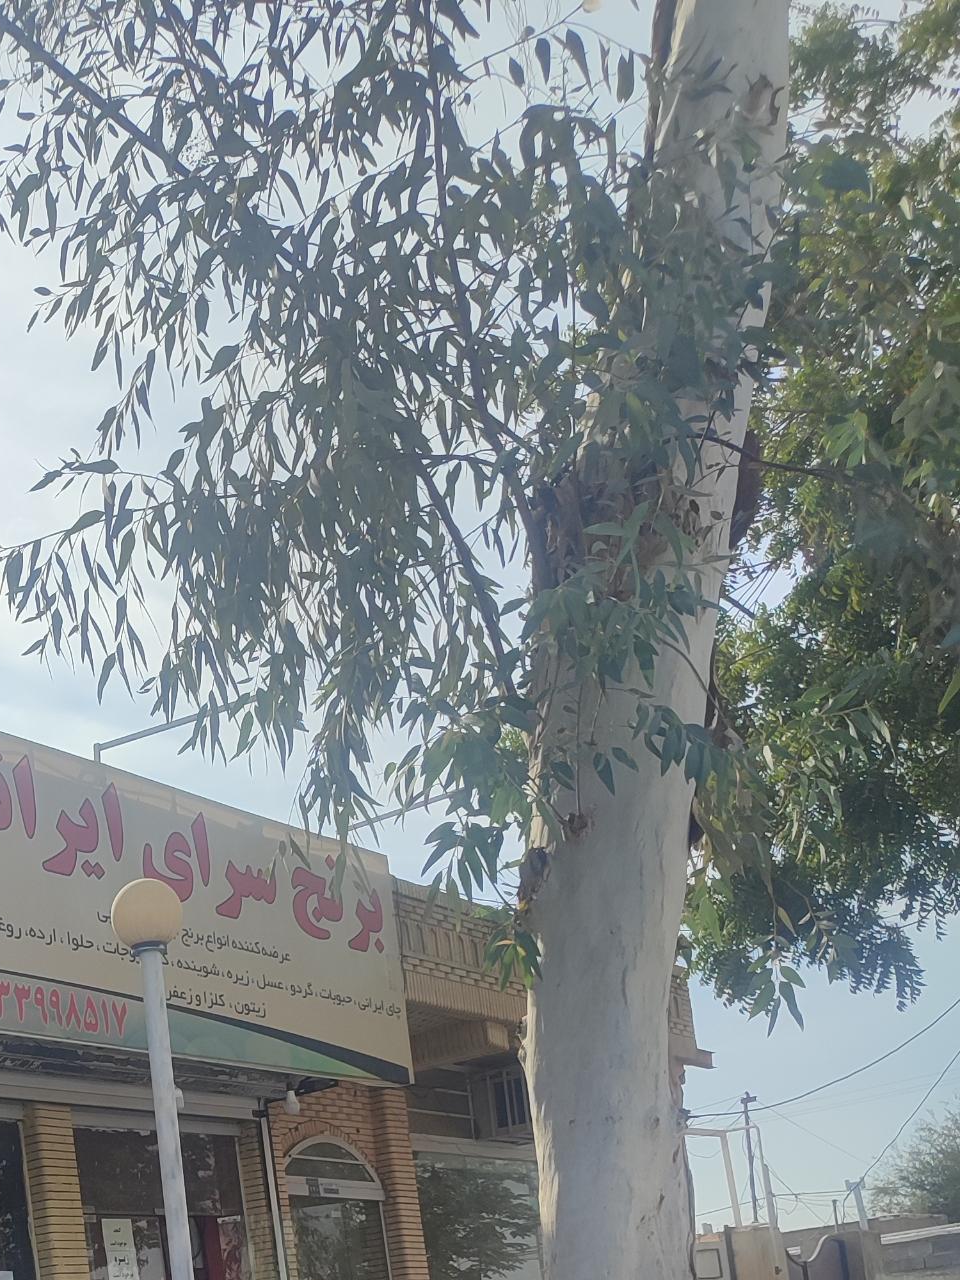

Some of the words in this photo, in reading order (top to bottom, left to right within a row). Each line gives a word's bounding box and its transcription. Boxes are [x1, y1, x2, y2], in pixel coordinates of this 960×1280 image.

[142, 811, 277, 920] سرای
[291, 854, 385, 954] برنج
[180, 926, 204, 947] برنج
[205, 934, 231, 952] انواع
[231, 938, 262, 955] کننده
[262, 947, 291, 964] عرضه
[166, 985, 193, 1006] زعفر
[203, 990, 226, 1009] کلزا
[384, 1004, 402, 1020] چای
